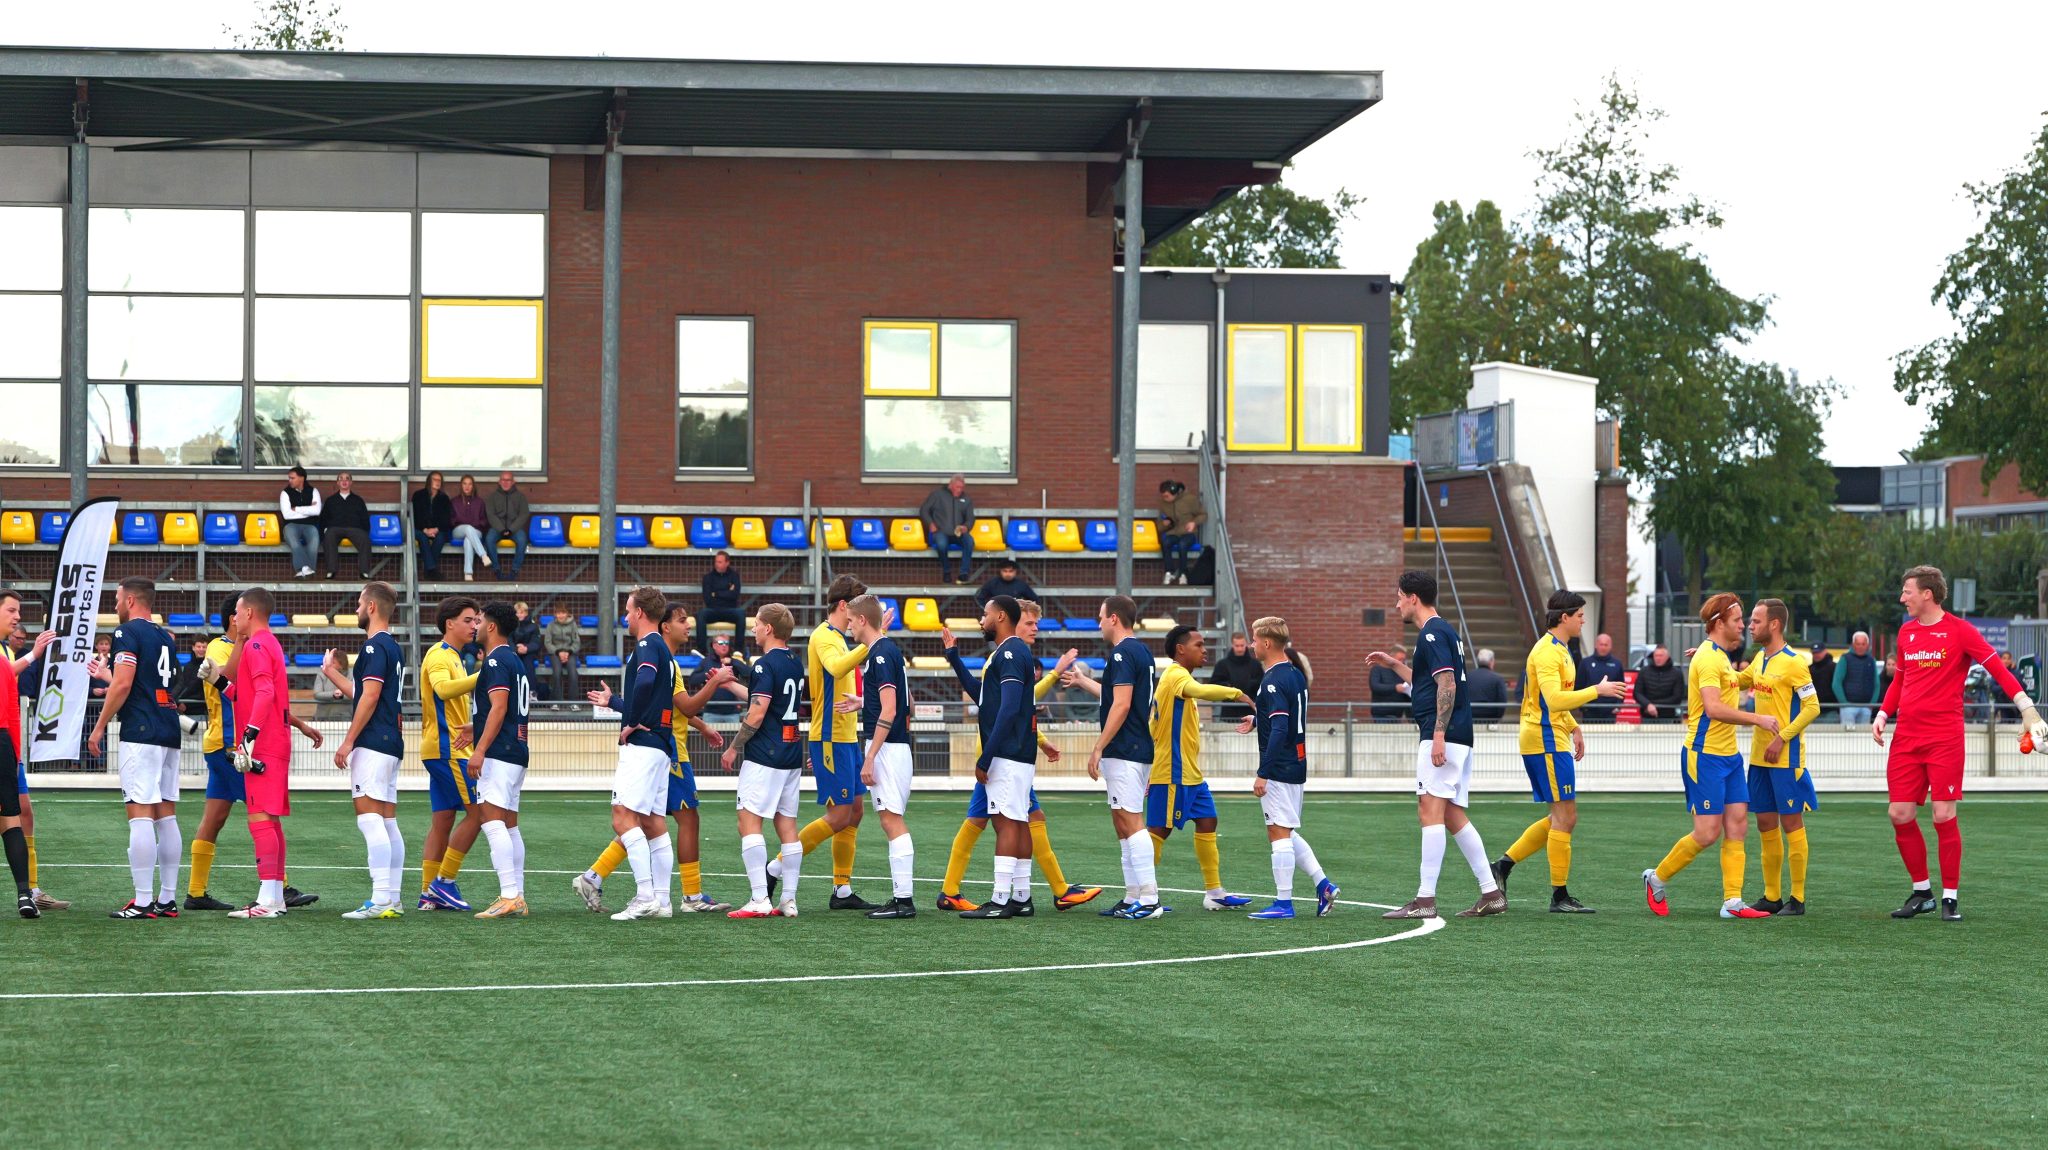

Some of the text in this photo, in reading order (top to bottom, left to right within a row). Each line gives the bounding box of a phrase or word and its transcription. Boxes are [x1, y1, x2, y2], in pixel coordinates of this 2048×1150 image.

[72, 563, 97, 664] sports.nl
[157, 645, 171, 688] 4
[516, 673, 530, 717] 10
[841, 788, 848, 799] 3
[1562, 784, 1572, 795] 11
[1703, 799, 1710, 810] 6
[1175, 810, 1182, 820] 9
